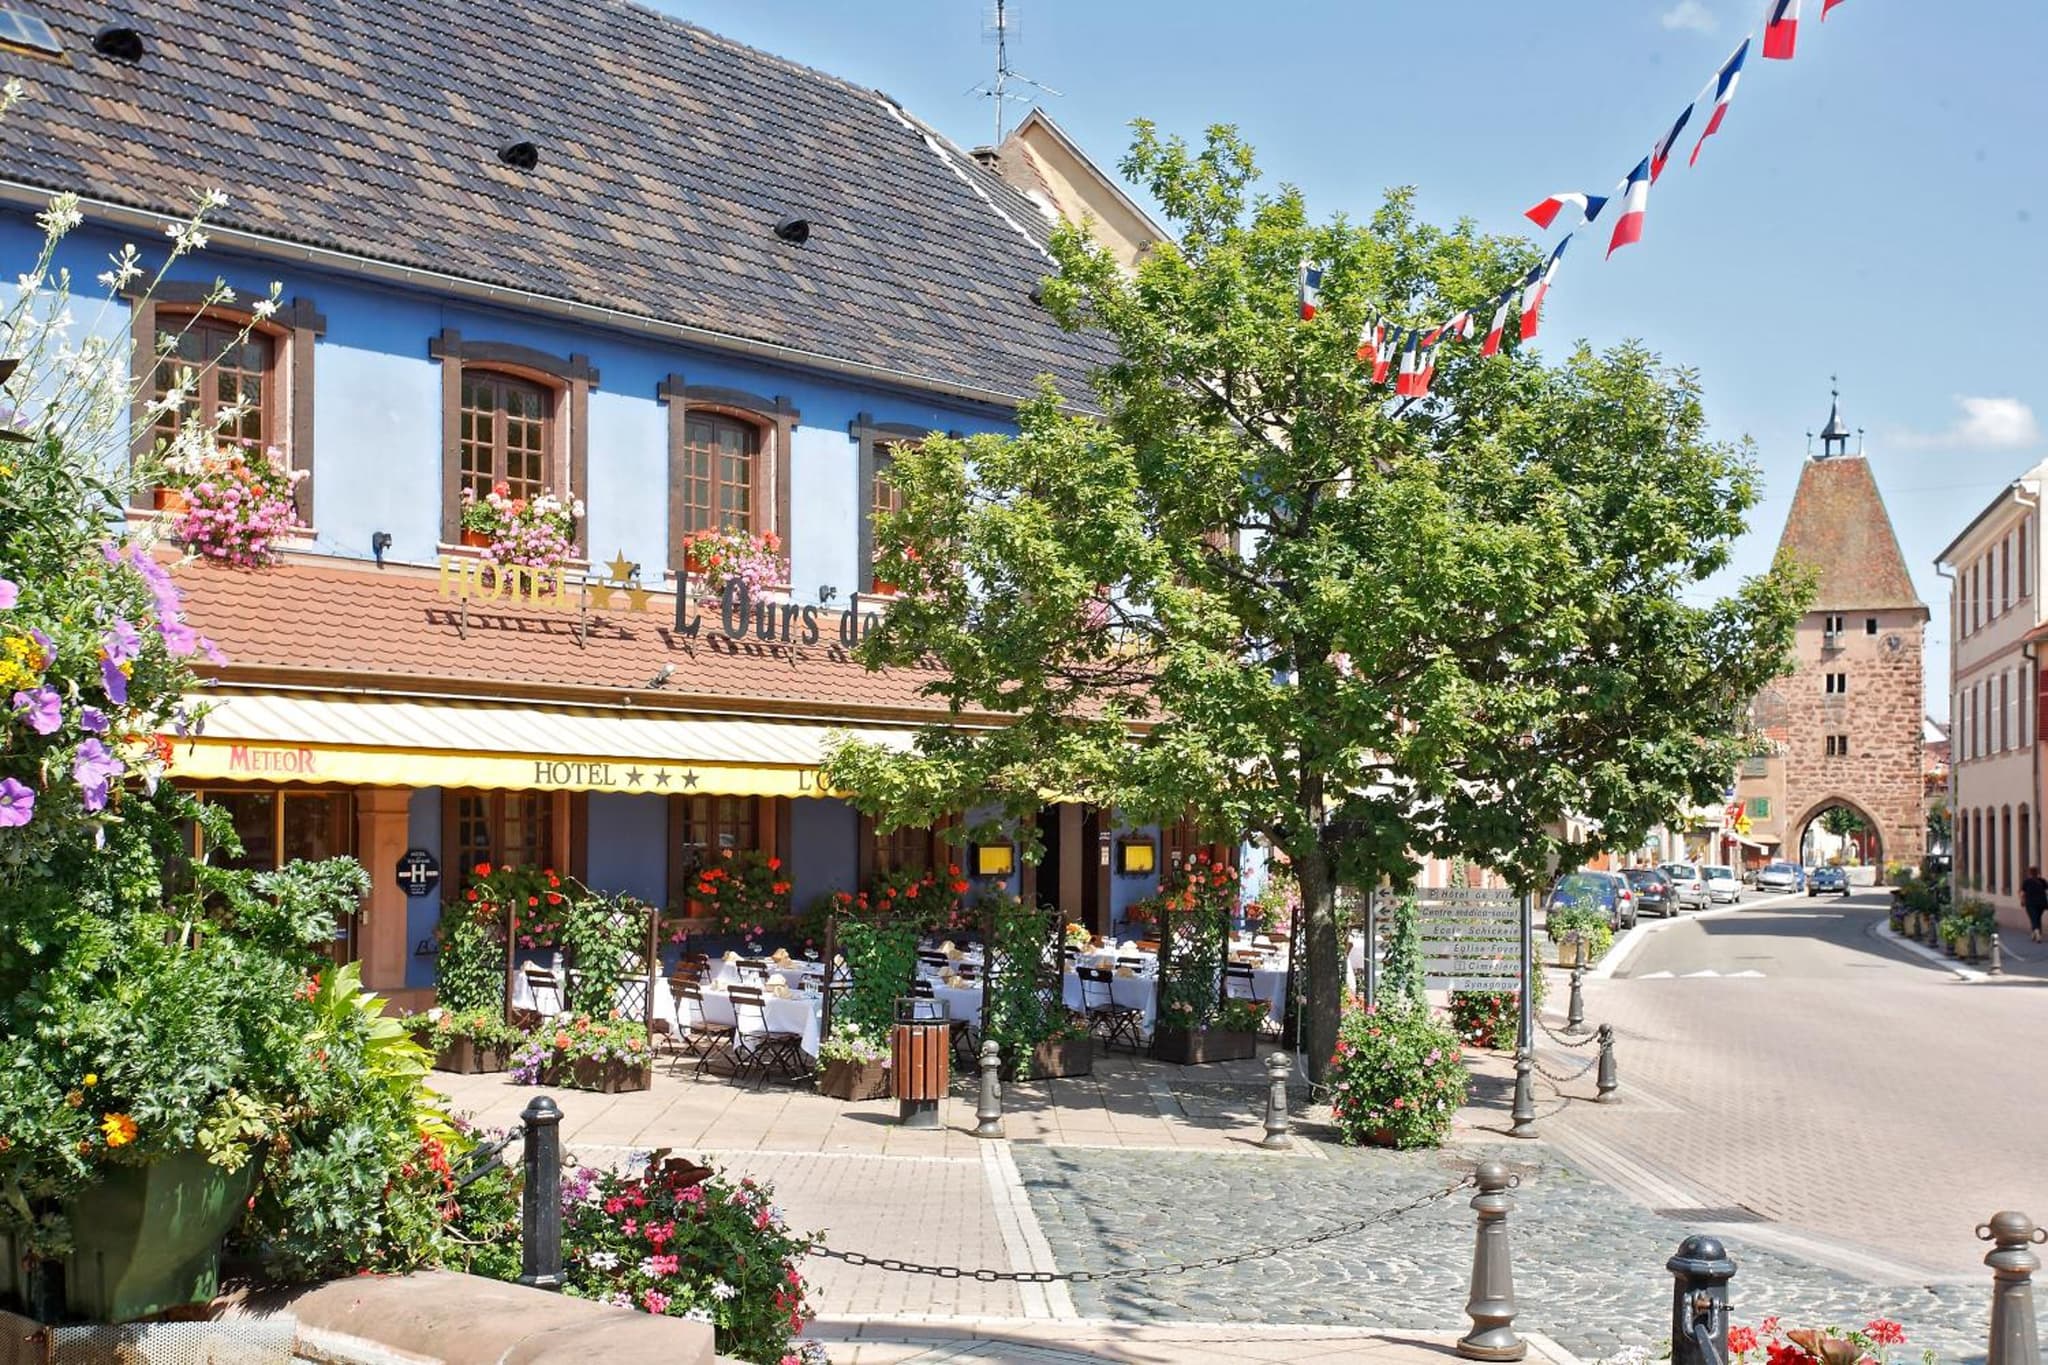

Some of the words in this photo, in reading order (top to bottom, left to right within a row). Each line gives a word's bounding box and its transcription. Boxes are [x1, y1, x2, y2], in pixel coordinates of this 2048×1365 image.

[438, 555, 577, 609] HOTEL
[534, 762, 617, 786] HOTEL
[411, 864, 426, 883] H
[1422, 907, 1453, 916] Centre
